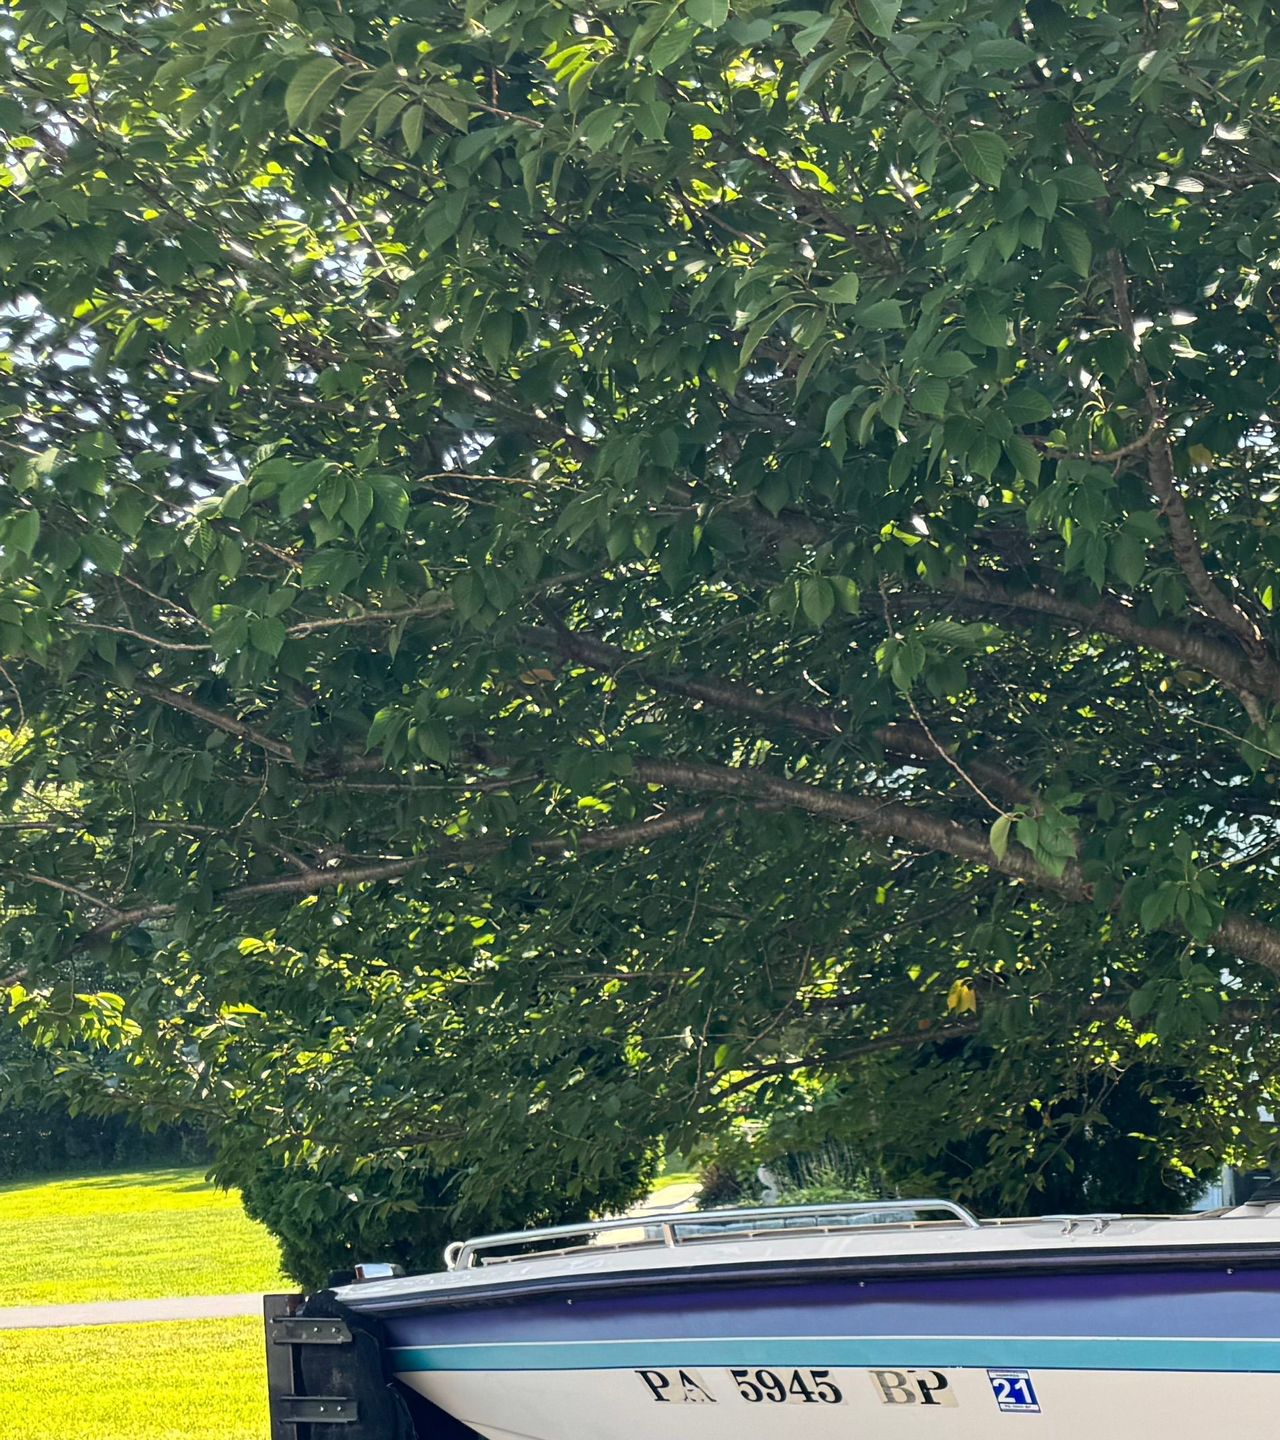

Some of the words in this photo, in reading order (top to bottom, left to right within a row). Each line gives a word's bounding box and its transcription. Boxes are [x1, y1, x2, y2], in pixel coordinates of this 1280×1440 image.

[635, 1369, 718, 1403] PA
[730, 1369, 844, 1404] 5945
[869, 1369, 949, 1406] BP
[992, 1378, 1033, 1404] 21
